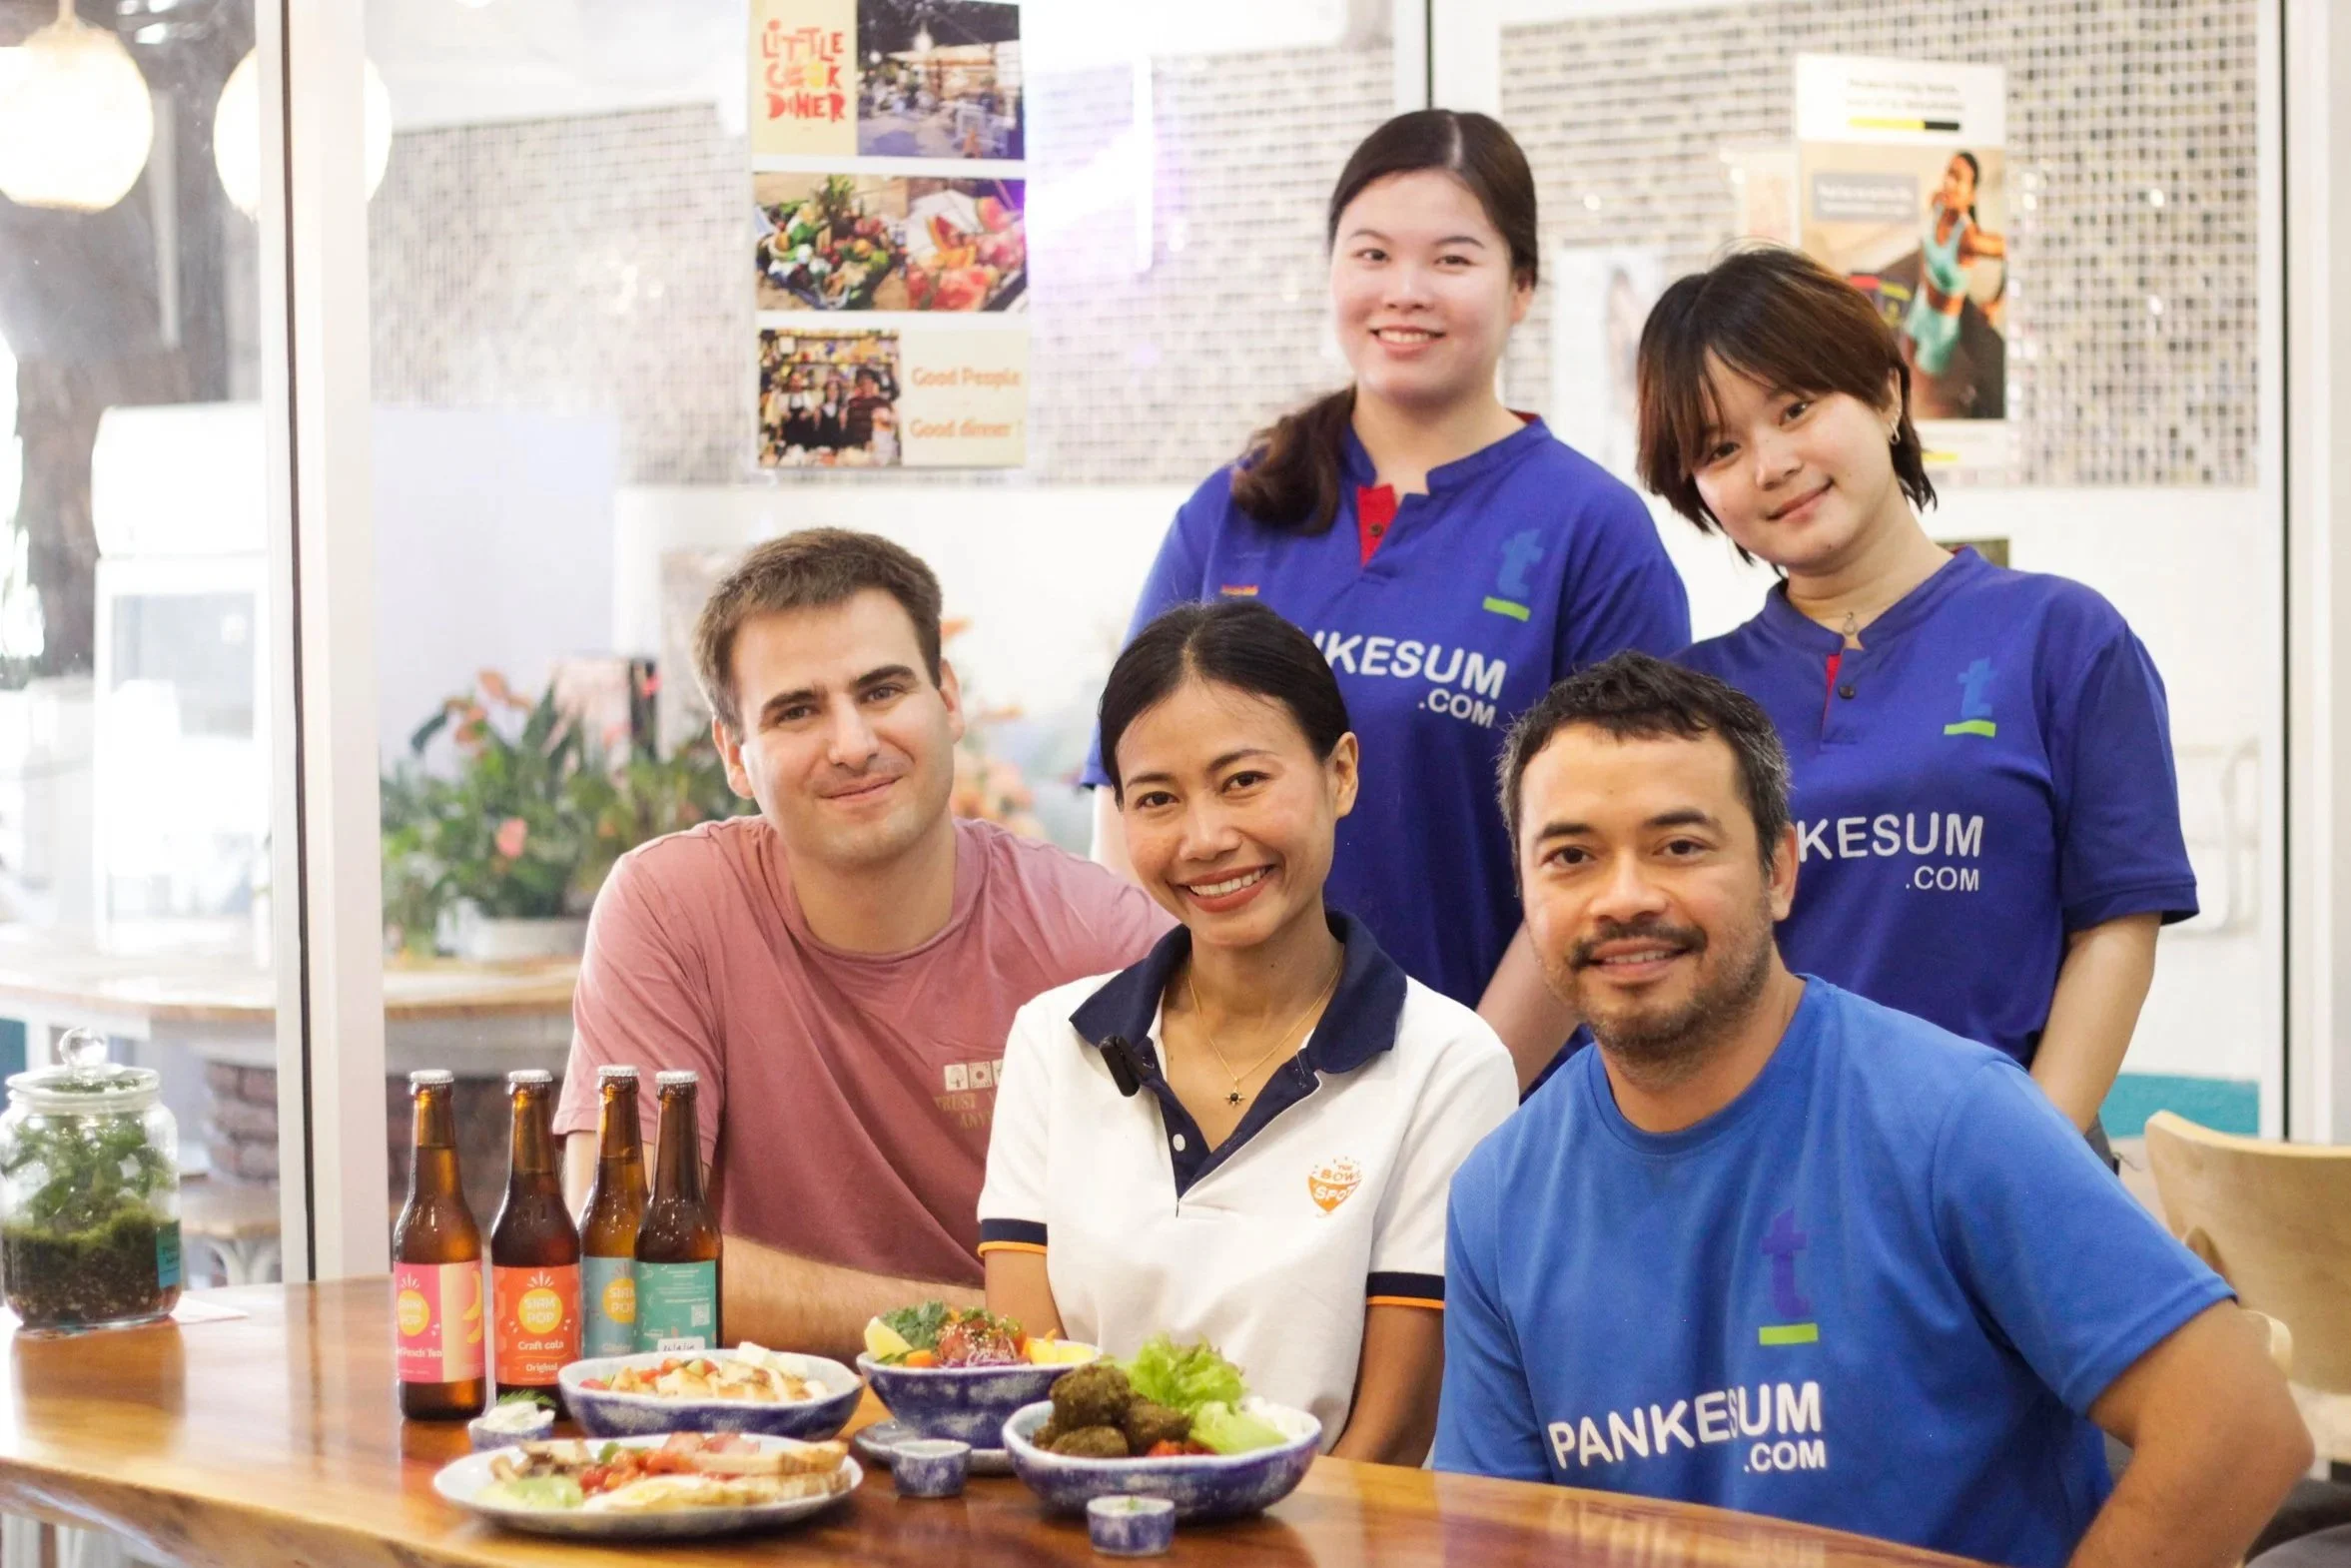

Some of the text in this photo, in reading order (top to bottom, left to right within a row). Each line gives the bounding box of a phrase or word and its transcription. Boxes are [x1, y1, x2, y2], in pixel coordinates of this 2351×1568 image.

[911, 368, 1022, 389] Good People
[909, 419, 955, 438] Good
[1418, 689, 1496, 729] .COM
[1905, 865, 1979, 892] .COM
[523, 1296, 556, 1308] SIAM
[526, 1311, 554, 1323] POP
[517, 1339, 565, 1351] Craft cola
[525, 1363, 558, 1373] Original
[1548, 1381, 1822, 1470] PANKESUM
[1744, 1439, 1827, 1473] .COM
